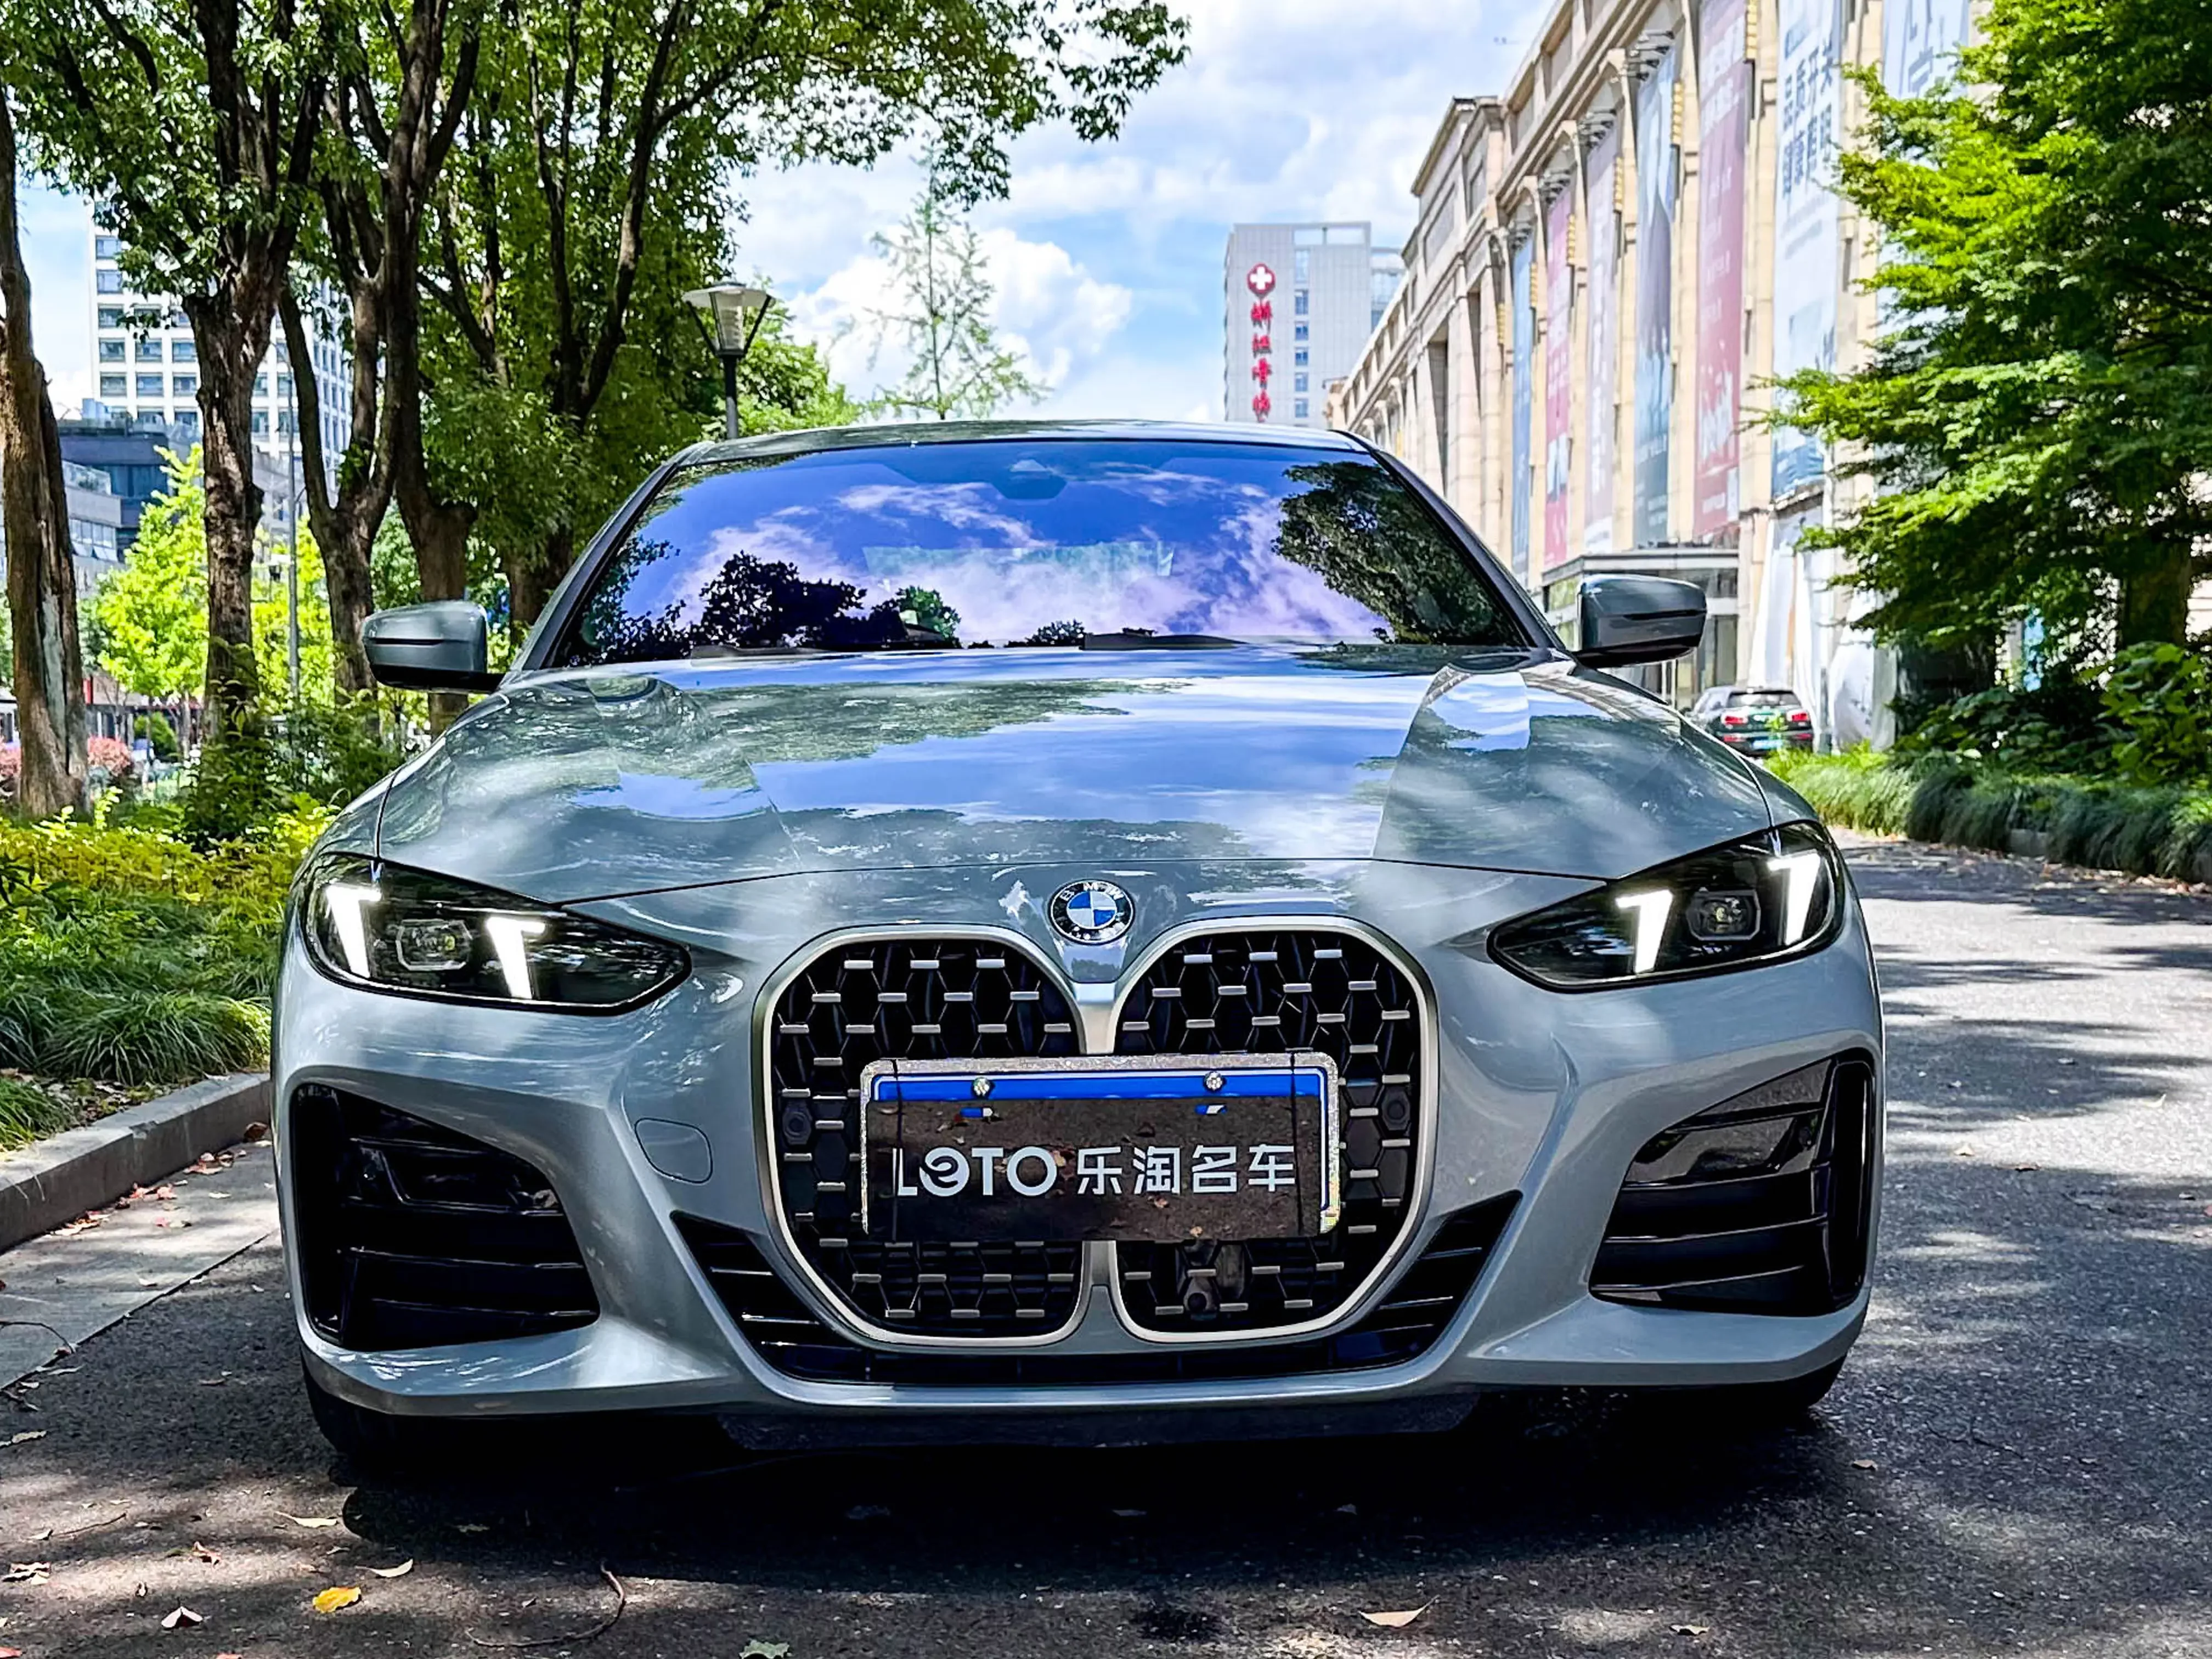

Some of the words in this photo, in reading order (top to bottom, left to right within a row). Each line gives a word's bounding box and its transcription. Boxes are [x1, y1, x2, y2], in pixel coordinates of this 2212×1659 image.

[1059, 882, 1125, 901] BMW
[1077, 1144, 1295, 1195] 乐淘名车
